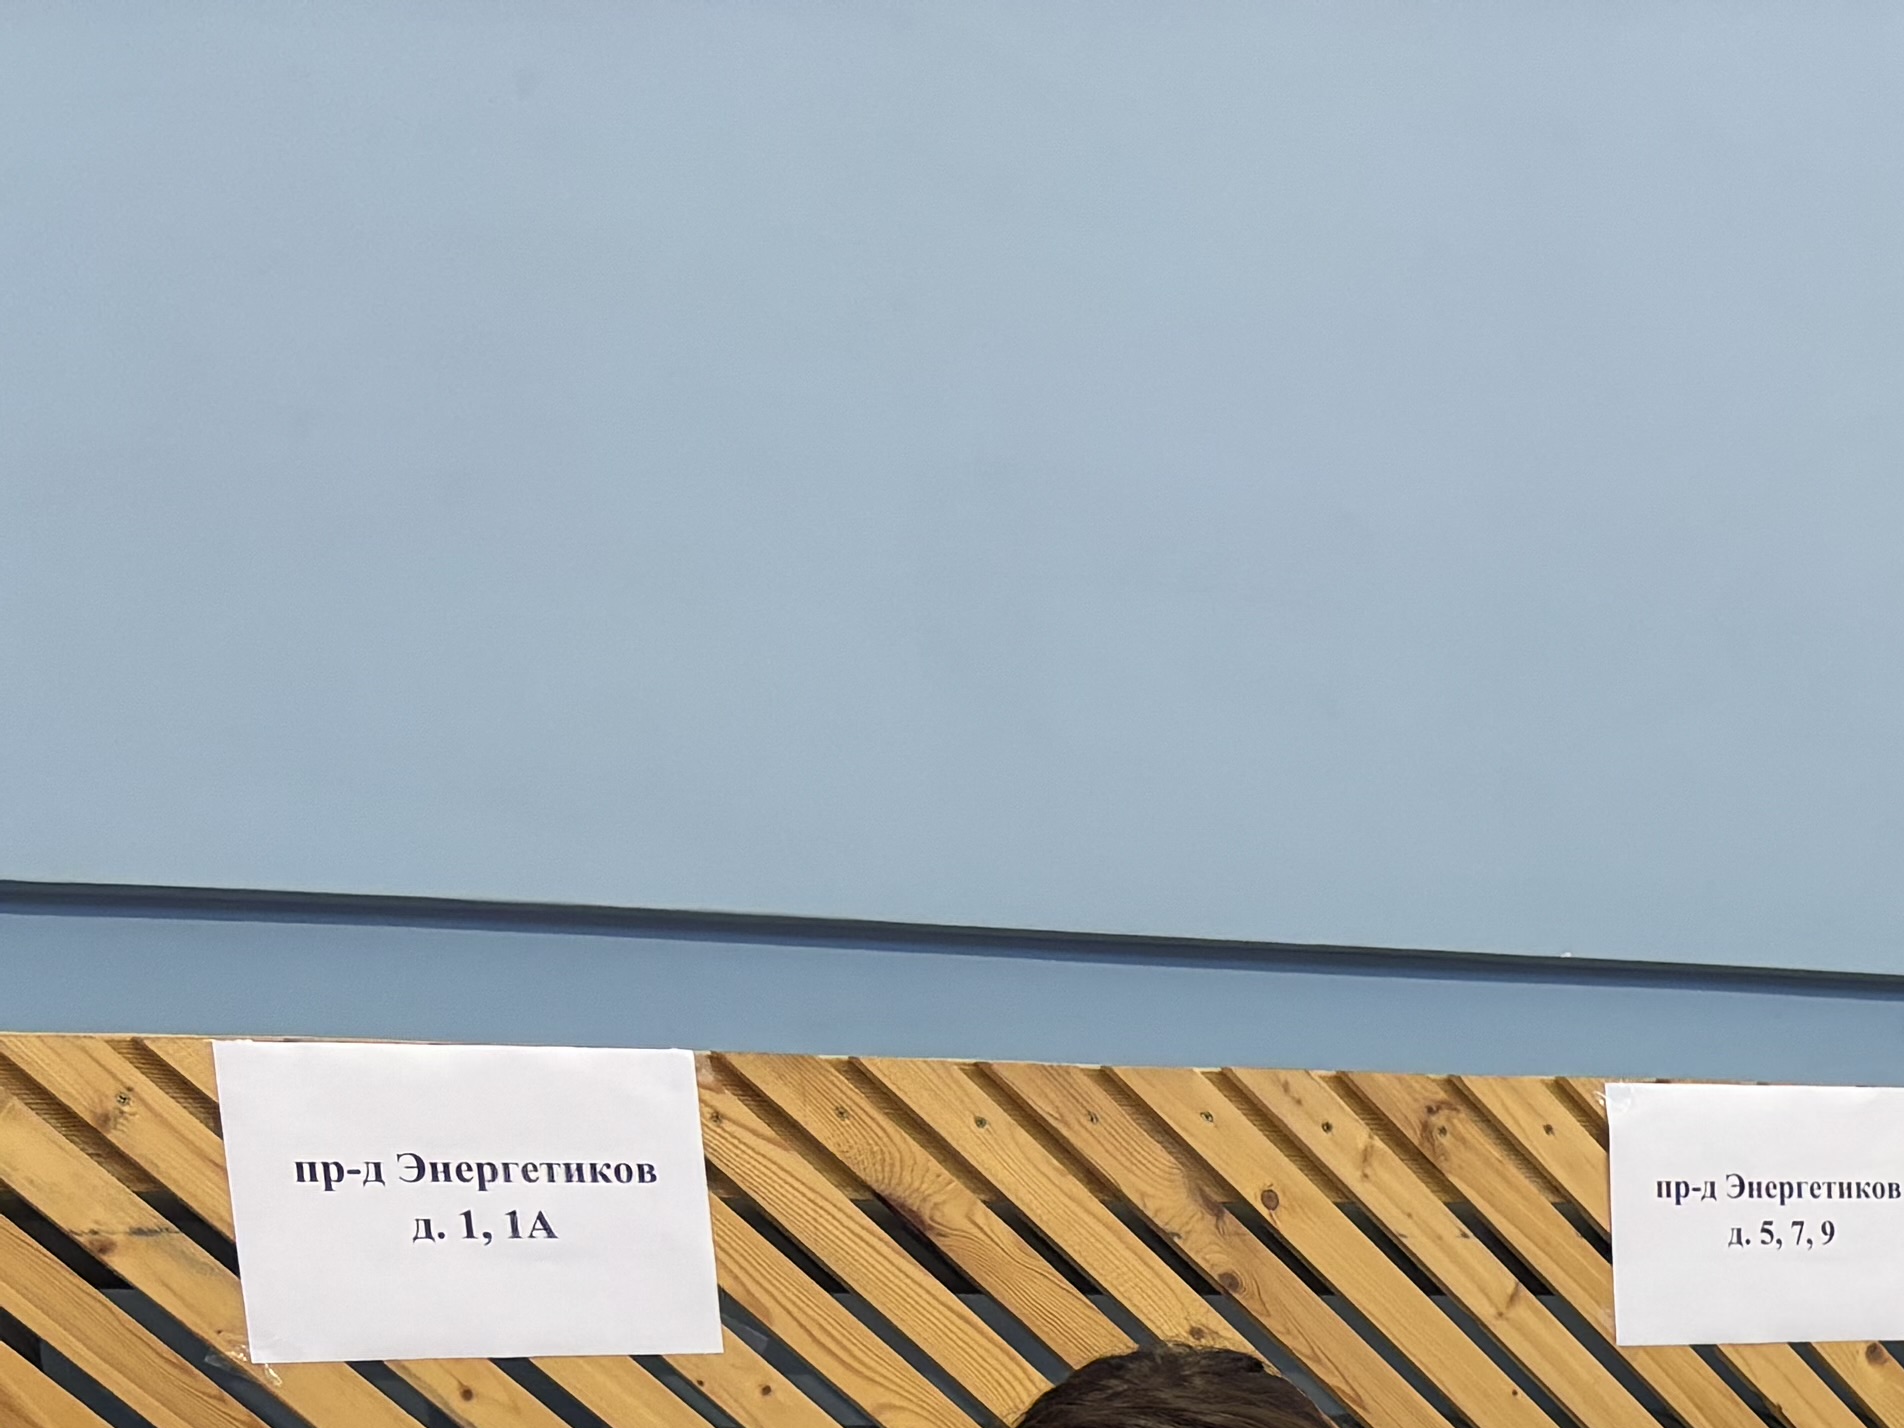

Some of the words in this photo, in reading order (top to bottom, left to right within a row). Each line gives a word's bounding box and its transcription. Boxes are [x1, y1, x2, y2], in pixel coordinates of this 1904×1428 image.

[294, 1161, 386, 1192] пр-д
[396, 1152, 657, 1192] Энергетиков
[1656, 1180, 1717, 1206] пр-д
[1725, 1173, 1902, 1206] Энергетиков
[412, 1218, 446, 1243] д.
[459, 1209, 493, 1246] 1,
[505, 1209, 559, 1239] 1А
[1728, 1227, 1751, 1247] д.
[1760, 1219, 1783, 1250] 5,
[1791, 1219, 1813, 1250] 7,
[1820, 1219, 1836, 1245] 9
